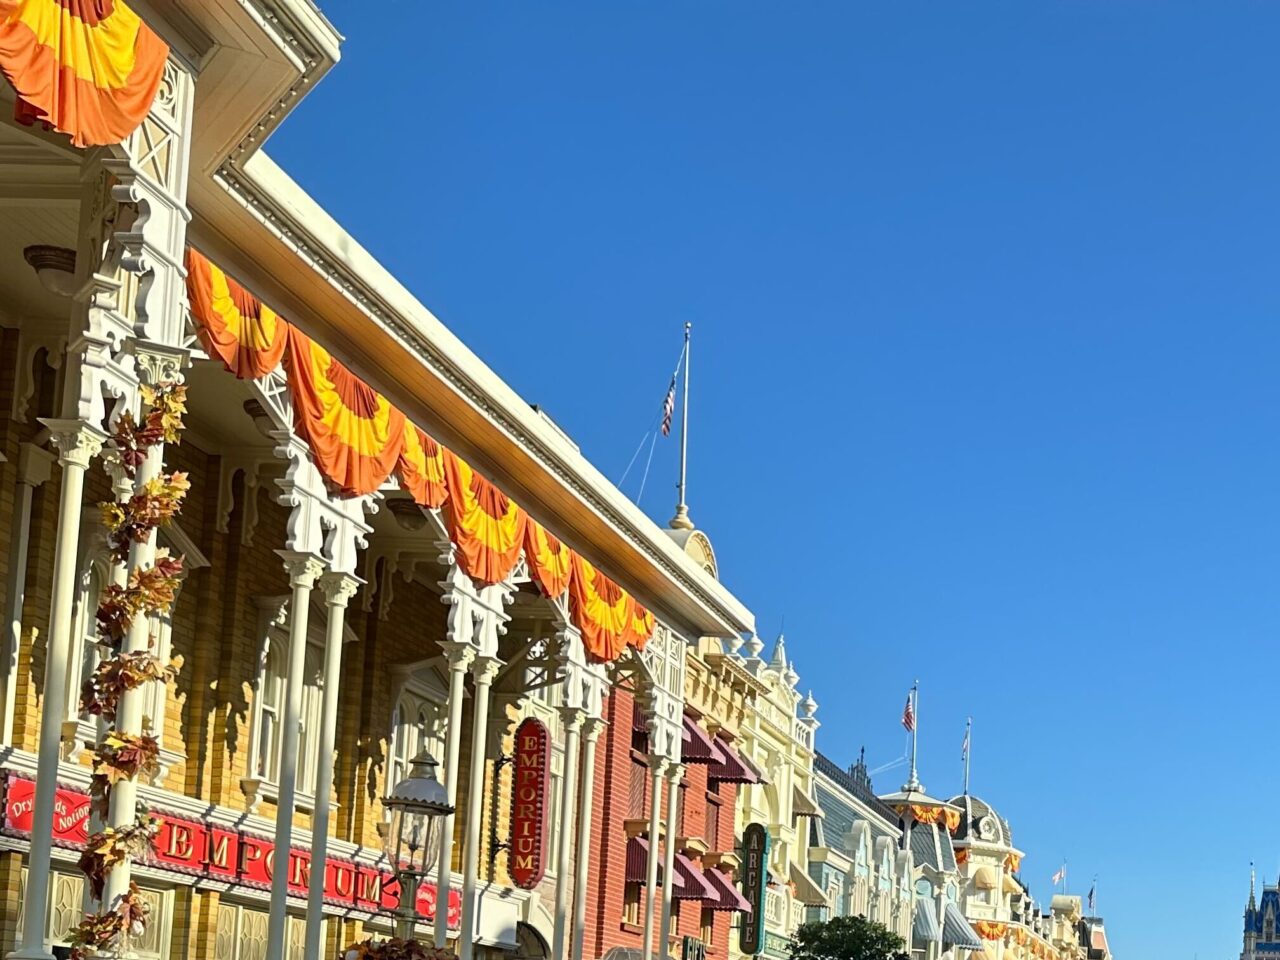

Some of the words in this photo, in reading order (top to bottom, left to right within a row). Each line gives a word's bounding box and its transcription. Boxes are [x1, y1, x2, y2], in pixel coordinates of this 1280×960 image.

[12, 798, 33, 817] Dry
[514, 736, 538, 870] EMPORIUM
[745, 834, 759, 943] ARCADE
